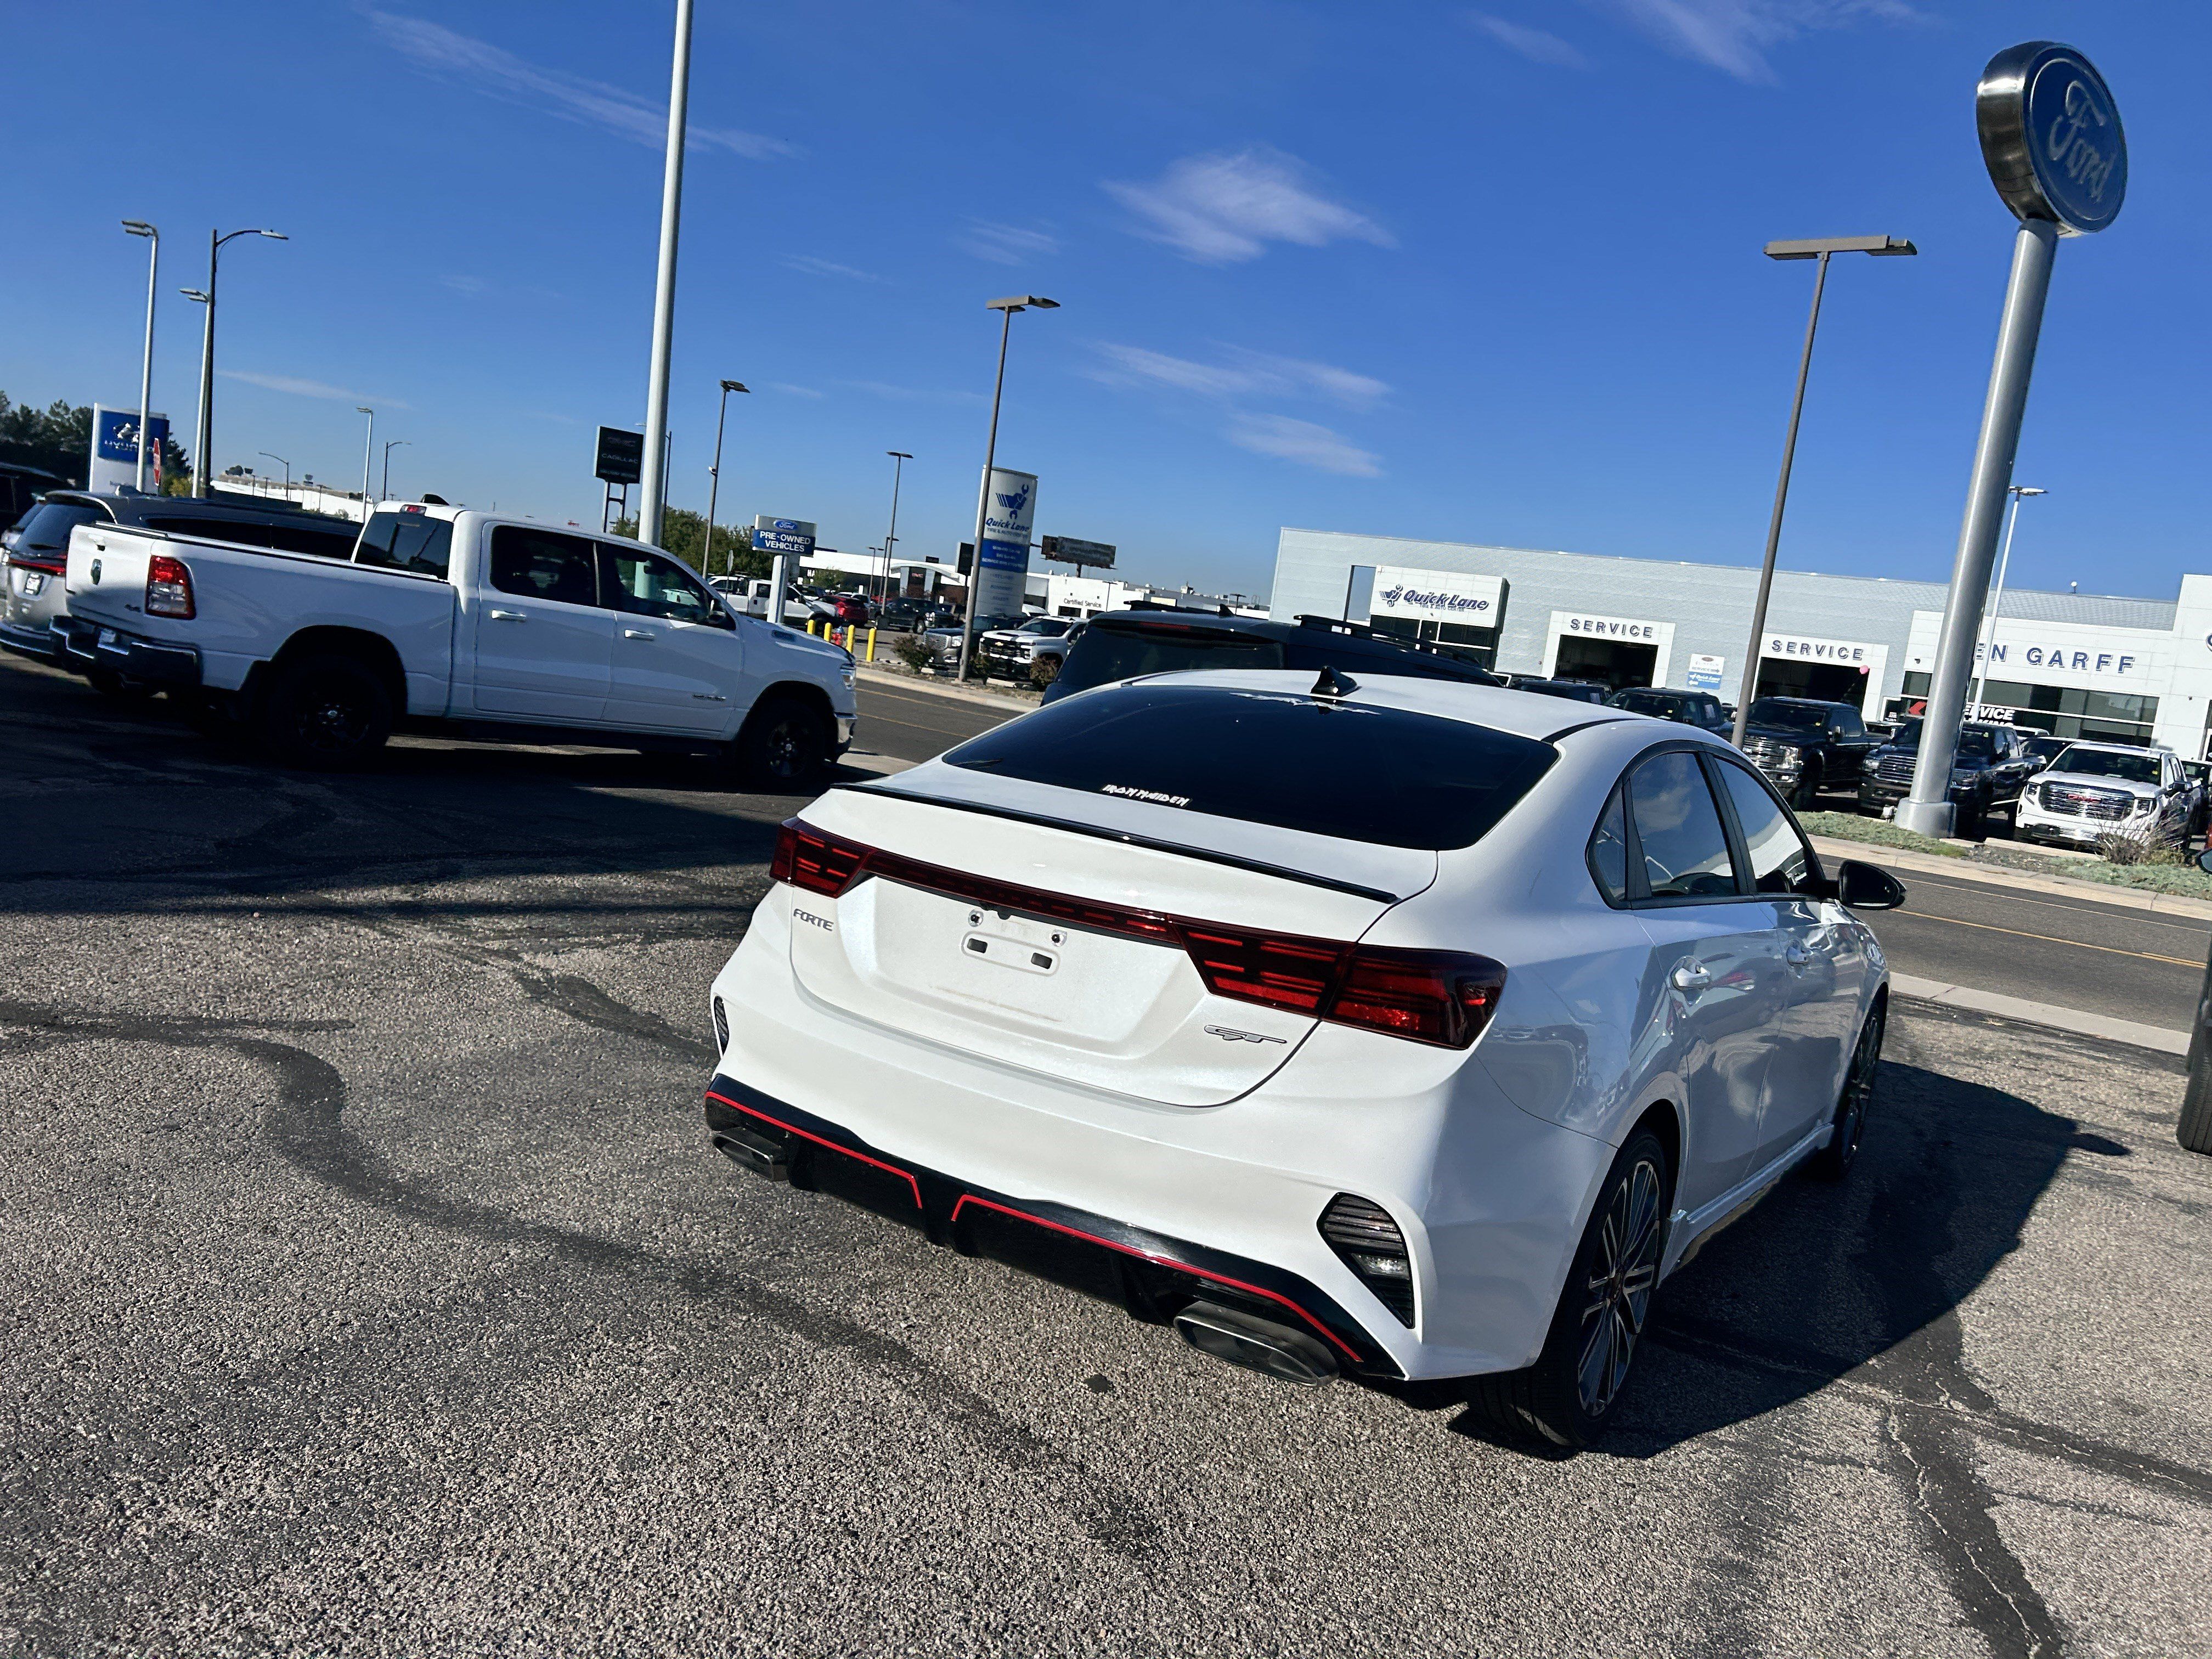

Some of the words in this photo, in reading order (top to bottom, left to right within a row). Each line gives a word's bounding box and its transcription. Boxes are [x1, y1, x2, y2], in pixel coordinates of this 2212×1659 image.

[2048, 81, 2117, 203] Ford
[779, 521, 795, 529] Ford
[985, 517, 1010, 528] Quick
[1011, 522, 1030, 532] Lane
[765, 540, 805, 552] VEHICLES
[1403, 590, 1450, 605] Quick
[1448, 595, 1489, 610] Lane
[1570, 619, 1653, 638] SERVICE
[1771, 640, 1864, 661] SERVICE
[1975, 642, 2008, 662] EN
[2027, 647, 2136, 674] GARFF
[1102, 785, 1138, 797] IRON
[1136, 789, 1190, 807] MAIDEN
[793, 908, 834, 932] FORTE
